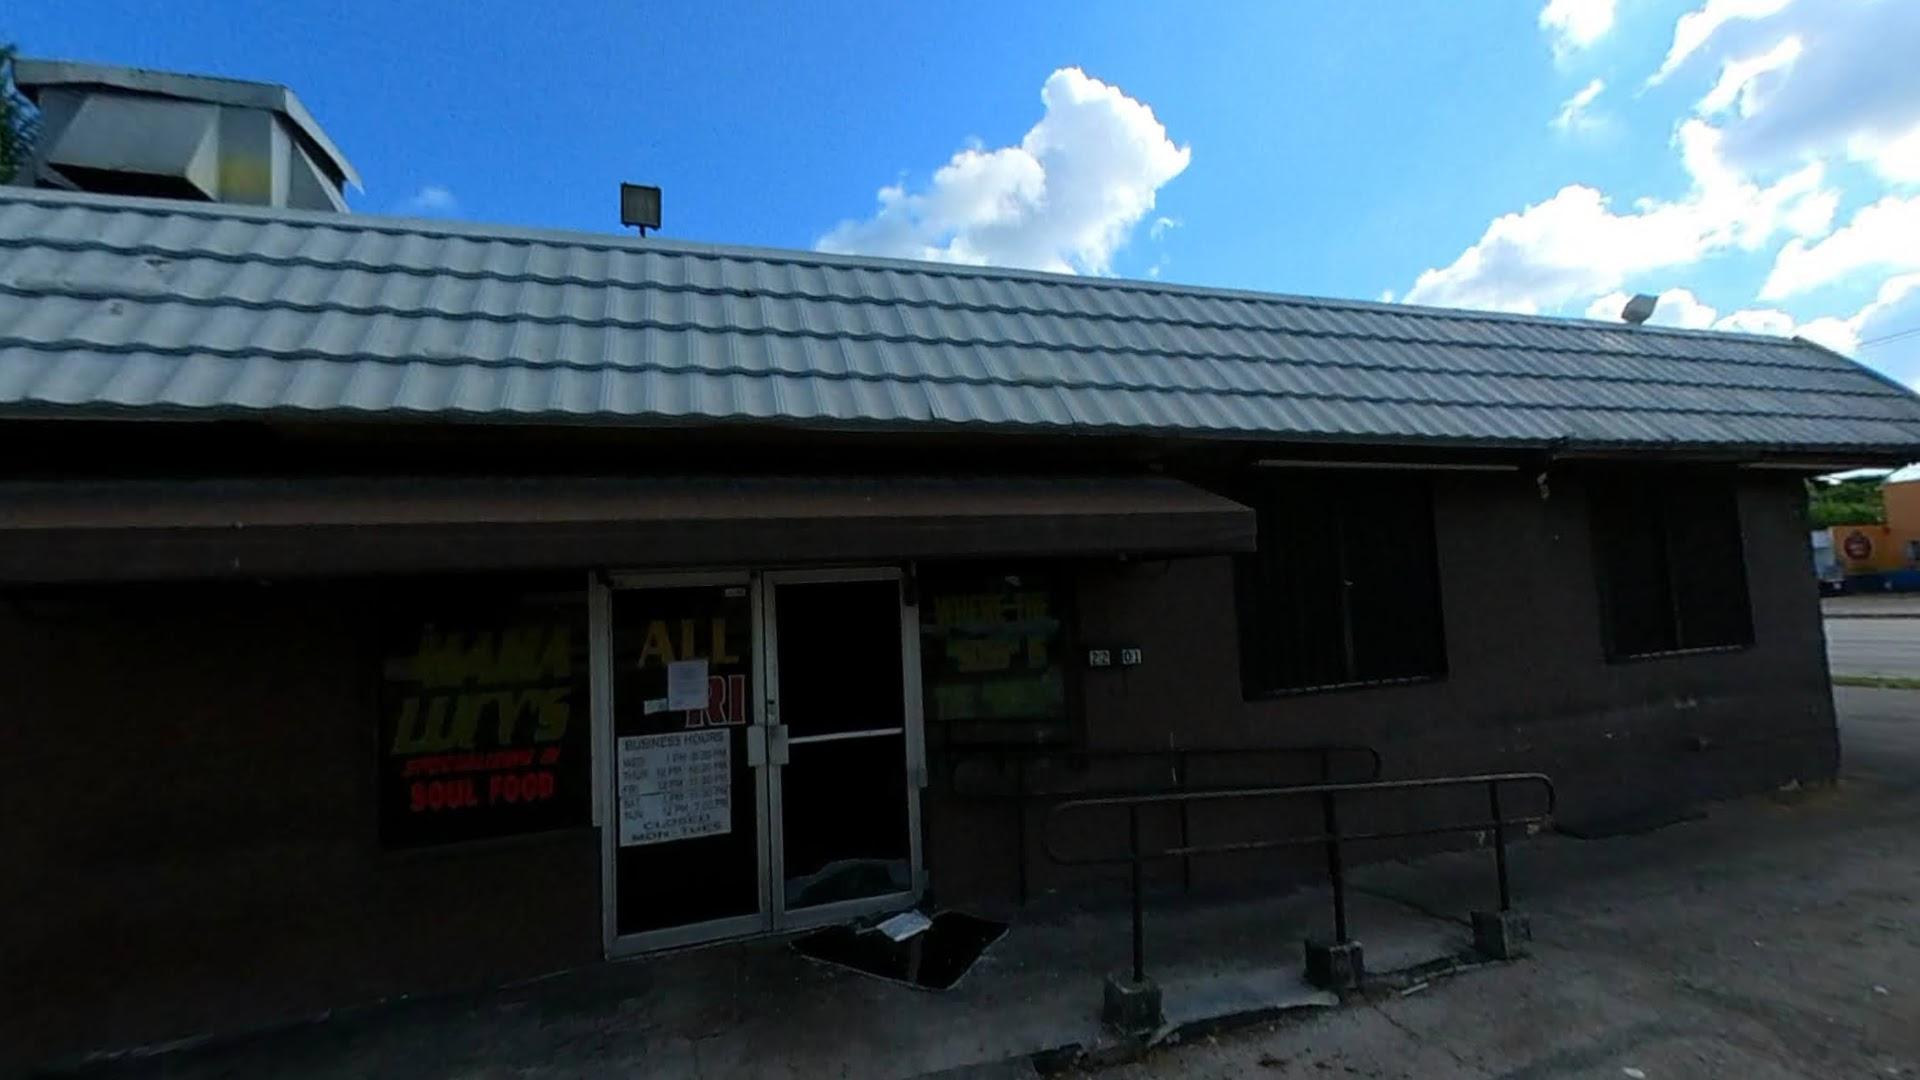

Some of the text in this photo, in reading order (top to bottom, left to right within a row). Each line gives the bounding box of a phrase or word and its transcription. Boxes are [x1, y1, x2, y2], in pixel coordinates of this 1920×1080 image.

[637, 617, 740, 667] ALL
[625, 731, 724, 751] BUSINESS HOURS
[410, 772, 554, 812] SOUL FOOD
[643, 814, 711, 829] CLOSED
